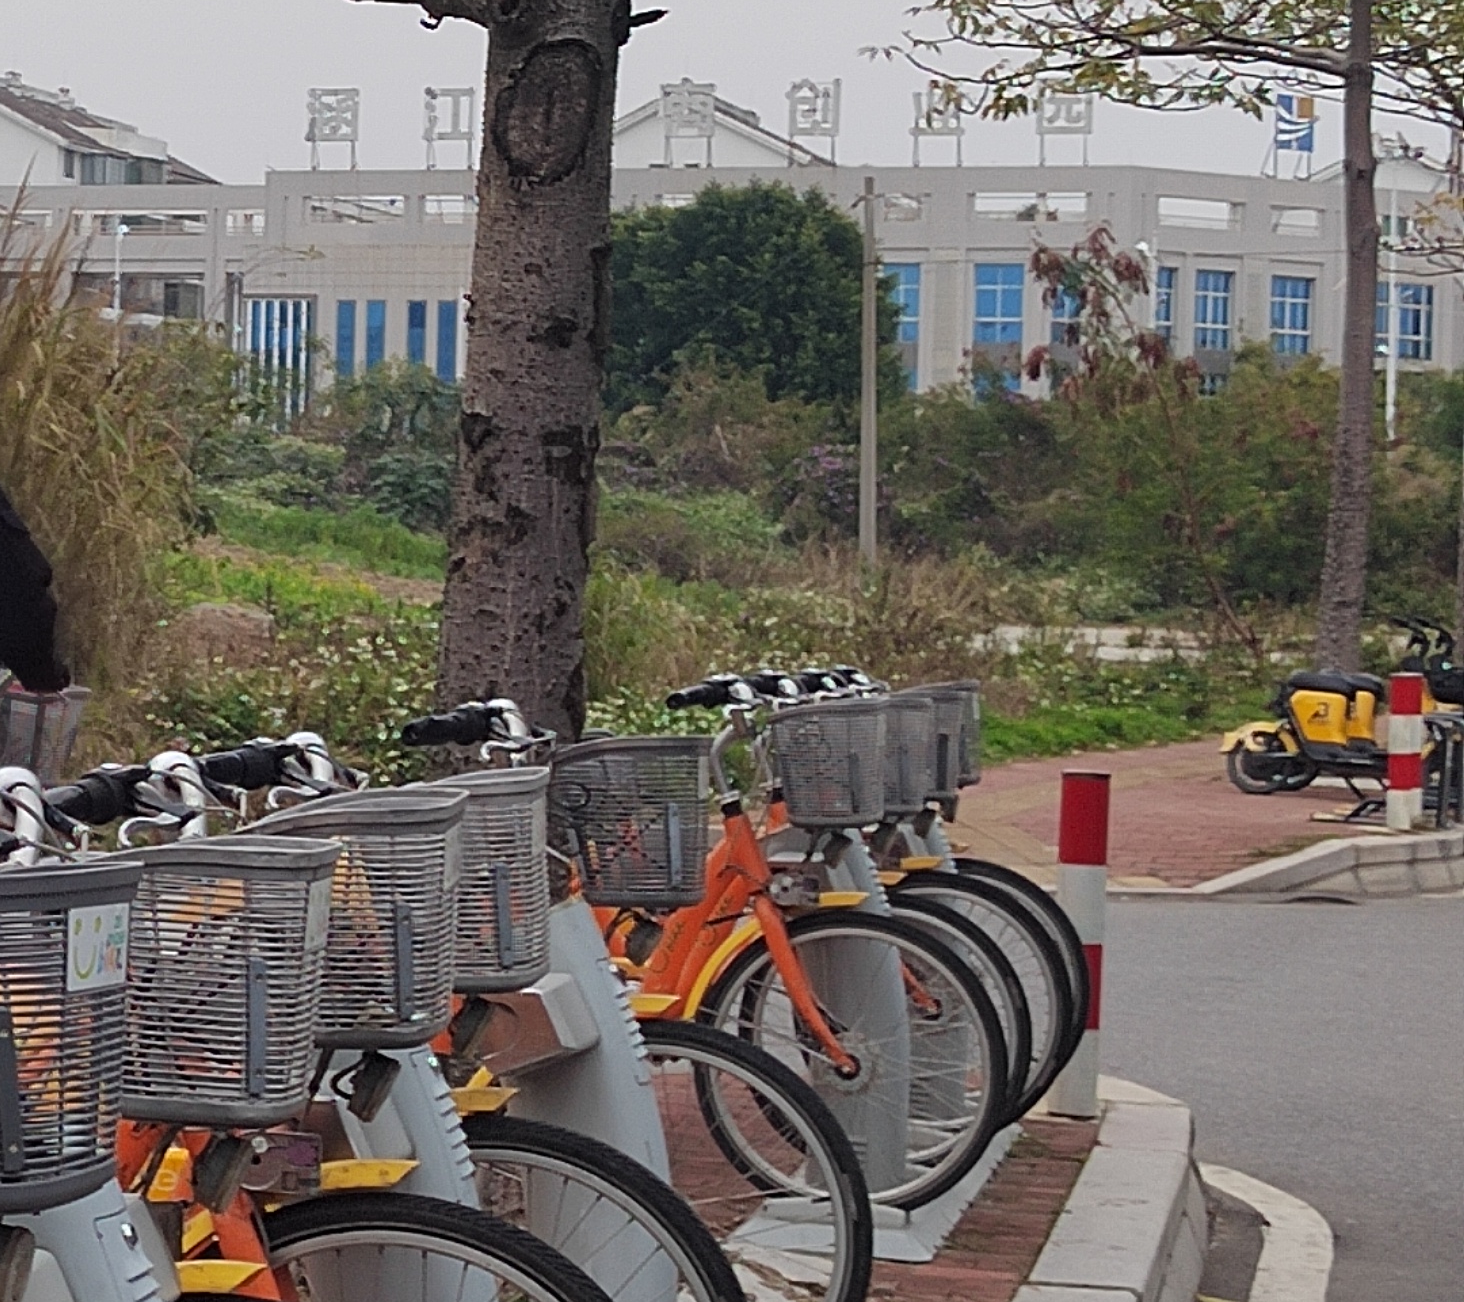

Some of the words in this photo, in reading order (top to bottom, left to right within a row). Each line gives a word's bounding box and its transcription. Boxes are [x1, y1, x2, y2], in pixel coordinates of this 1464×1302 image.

[304, 78, 1093, 141] 涵江商创业园
